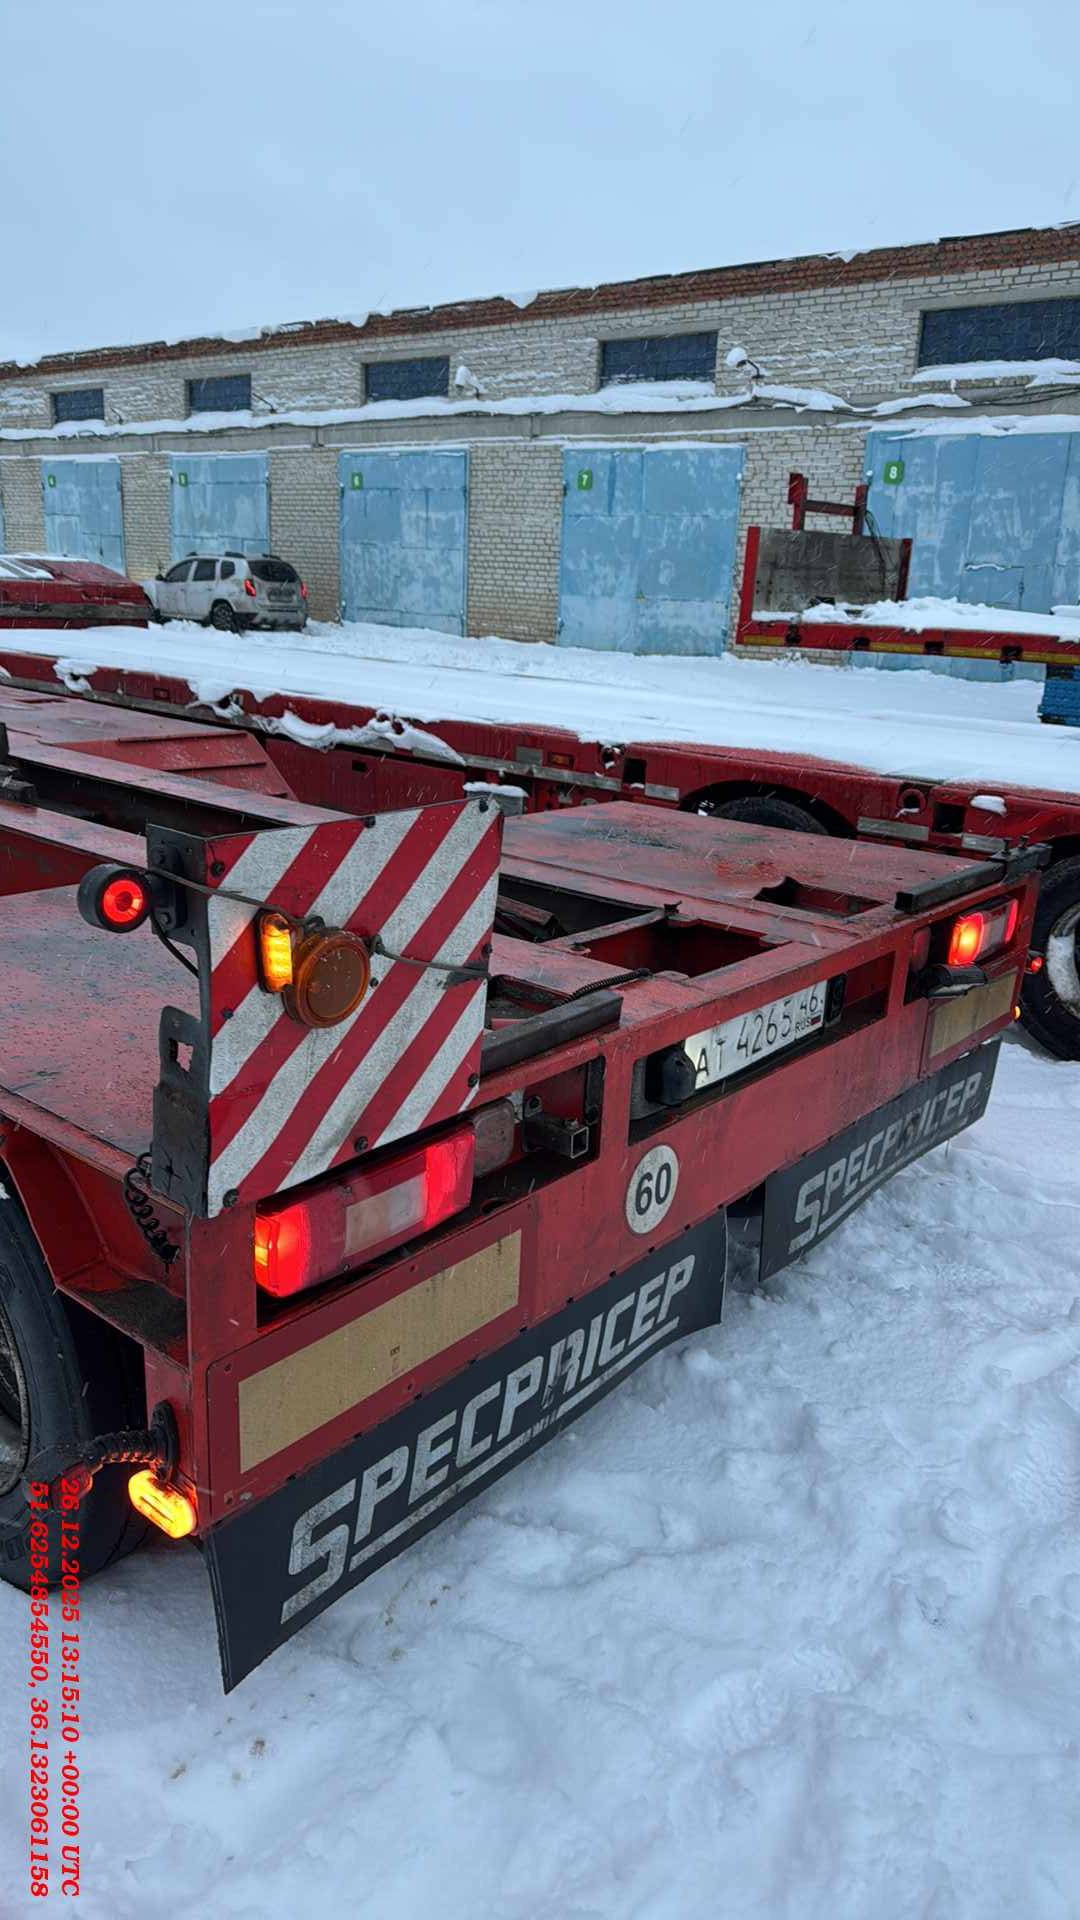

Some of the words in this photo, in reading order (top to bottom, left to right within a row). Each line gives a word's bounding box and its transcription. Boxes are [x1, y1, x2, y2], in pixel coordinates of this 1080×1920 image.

[582, 474, 589, 486] 7
[889, 465, 898, 479] 8
[696, 1036, 727, 1077] AT
[736, 999, 793, 1058] 4265
[799, 984, 818, 1016] 46
[635, 1162, 672, 1216] 60
[280, 1254, 696, 1625] SPECPRICEP
